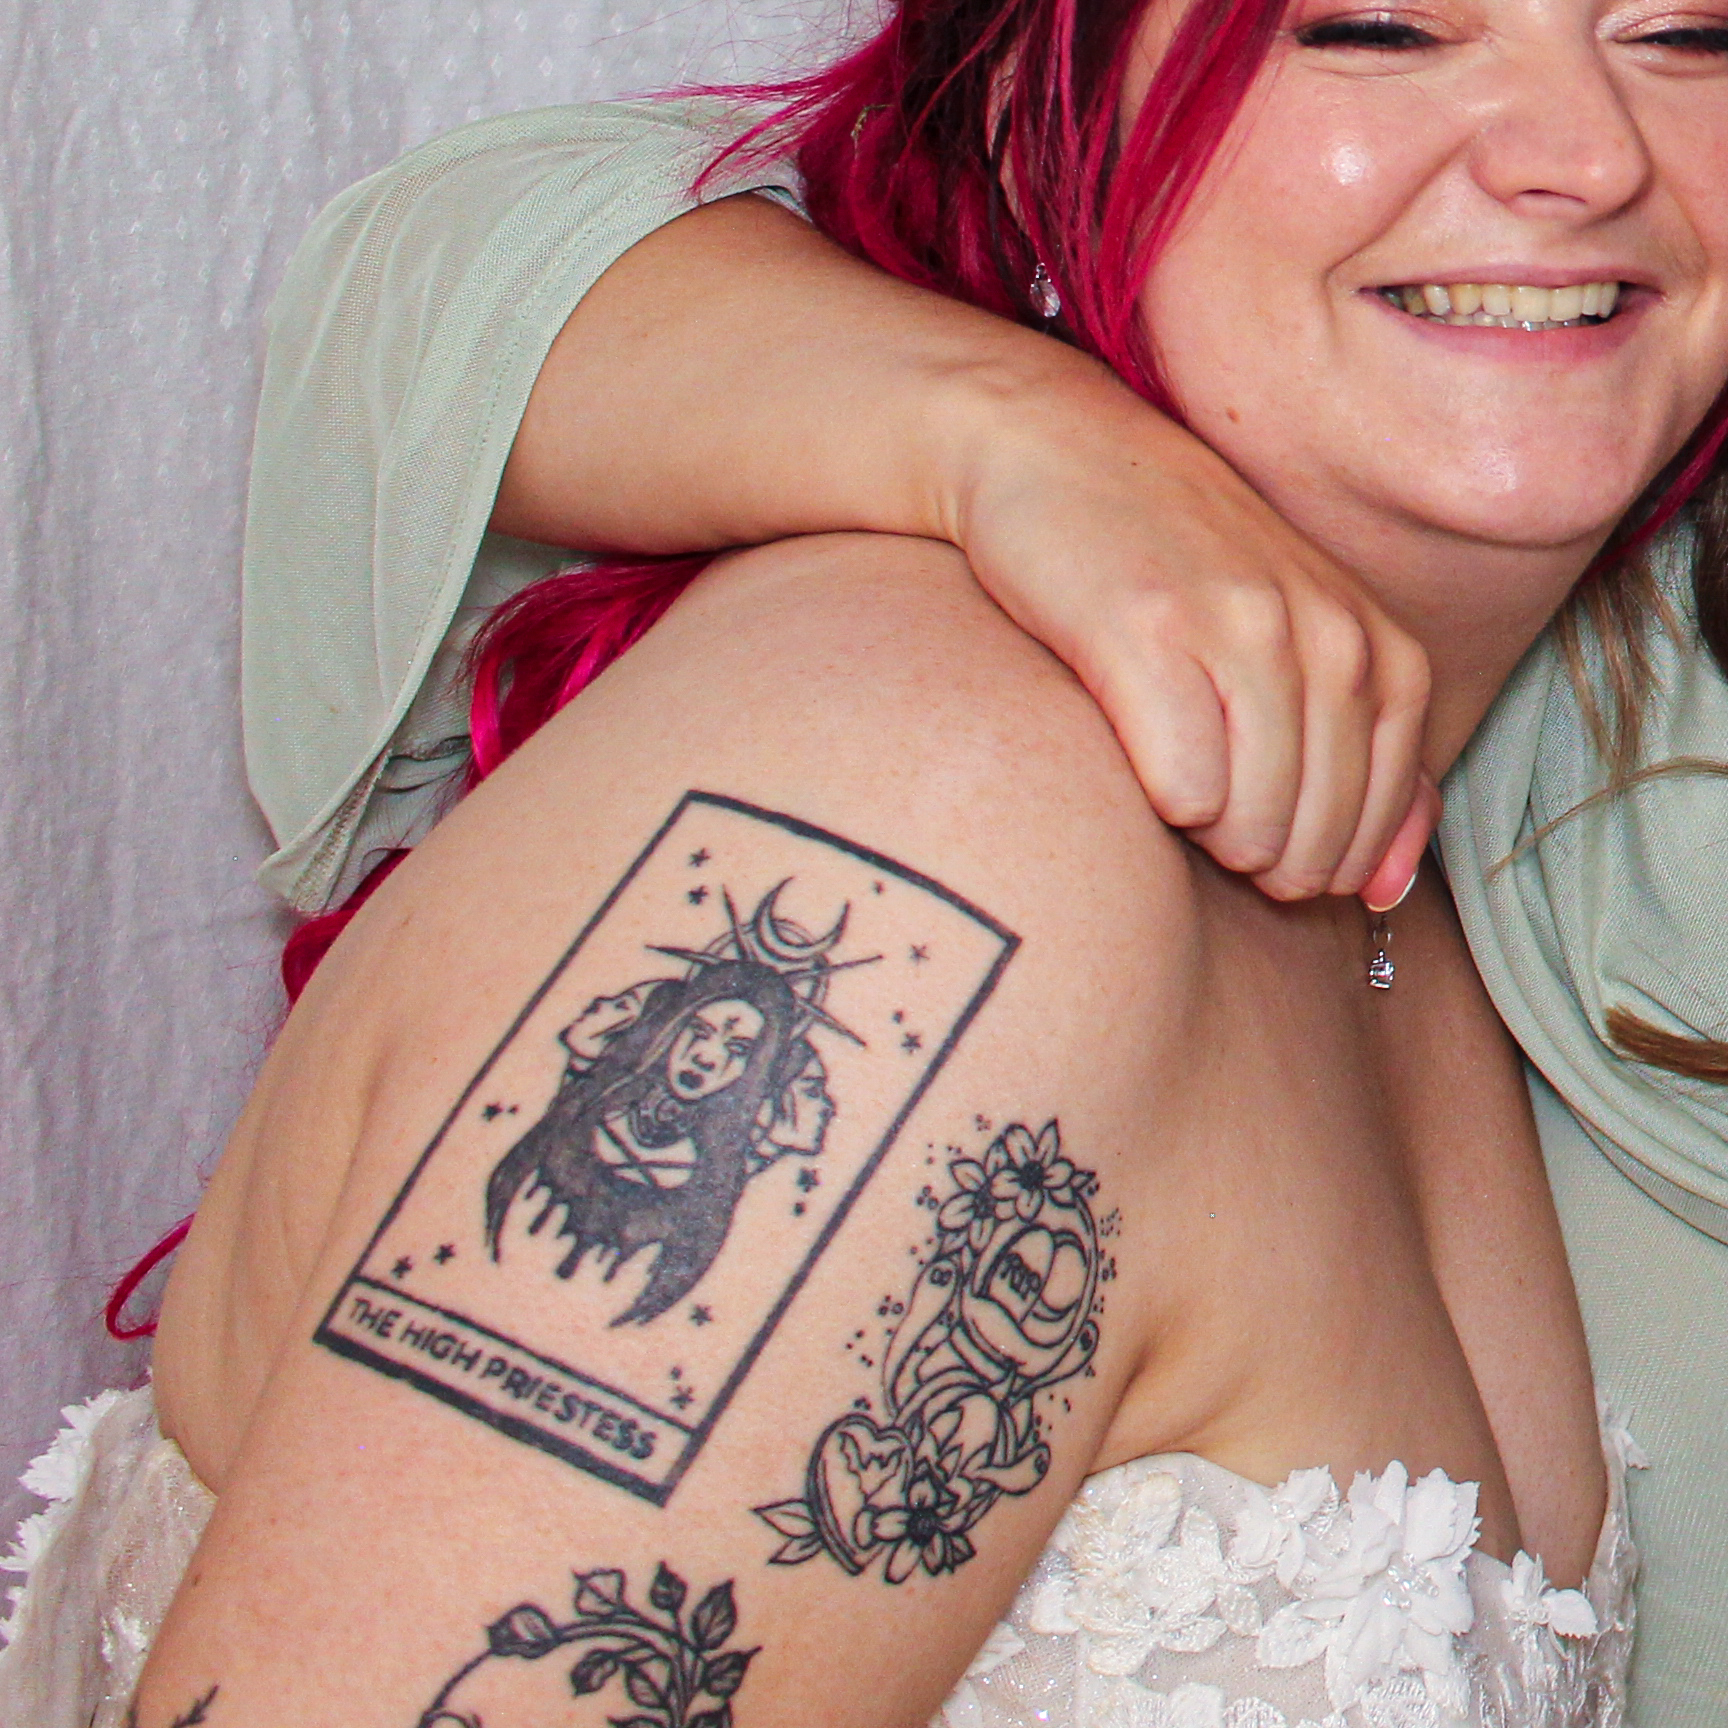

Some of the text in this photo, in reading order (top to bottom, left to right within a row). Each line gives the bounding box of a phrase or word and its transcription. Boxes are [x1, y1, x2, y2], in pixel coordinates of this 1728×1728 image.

[350, 1296, 657, 1460] THE HIGH PRIESTESS
